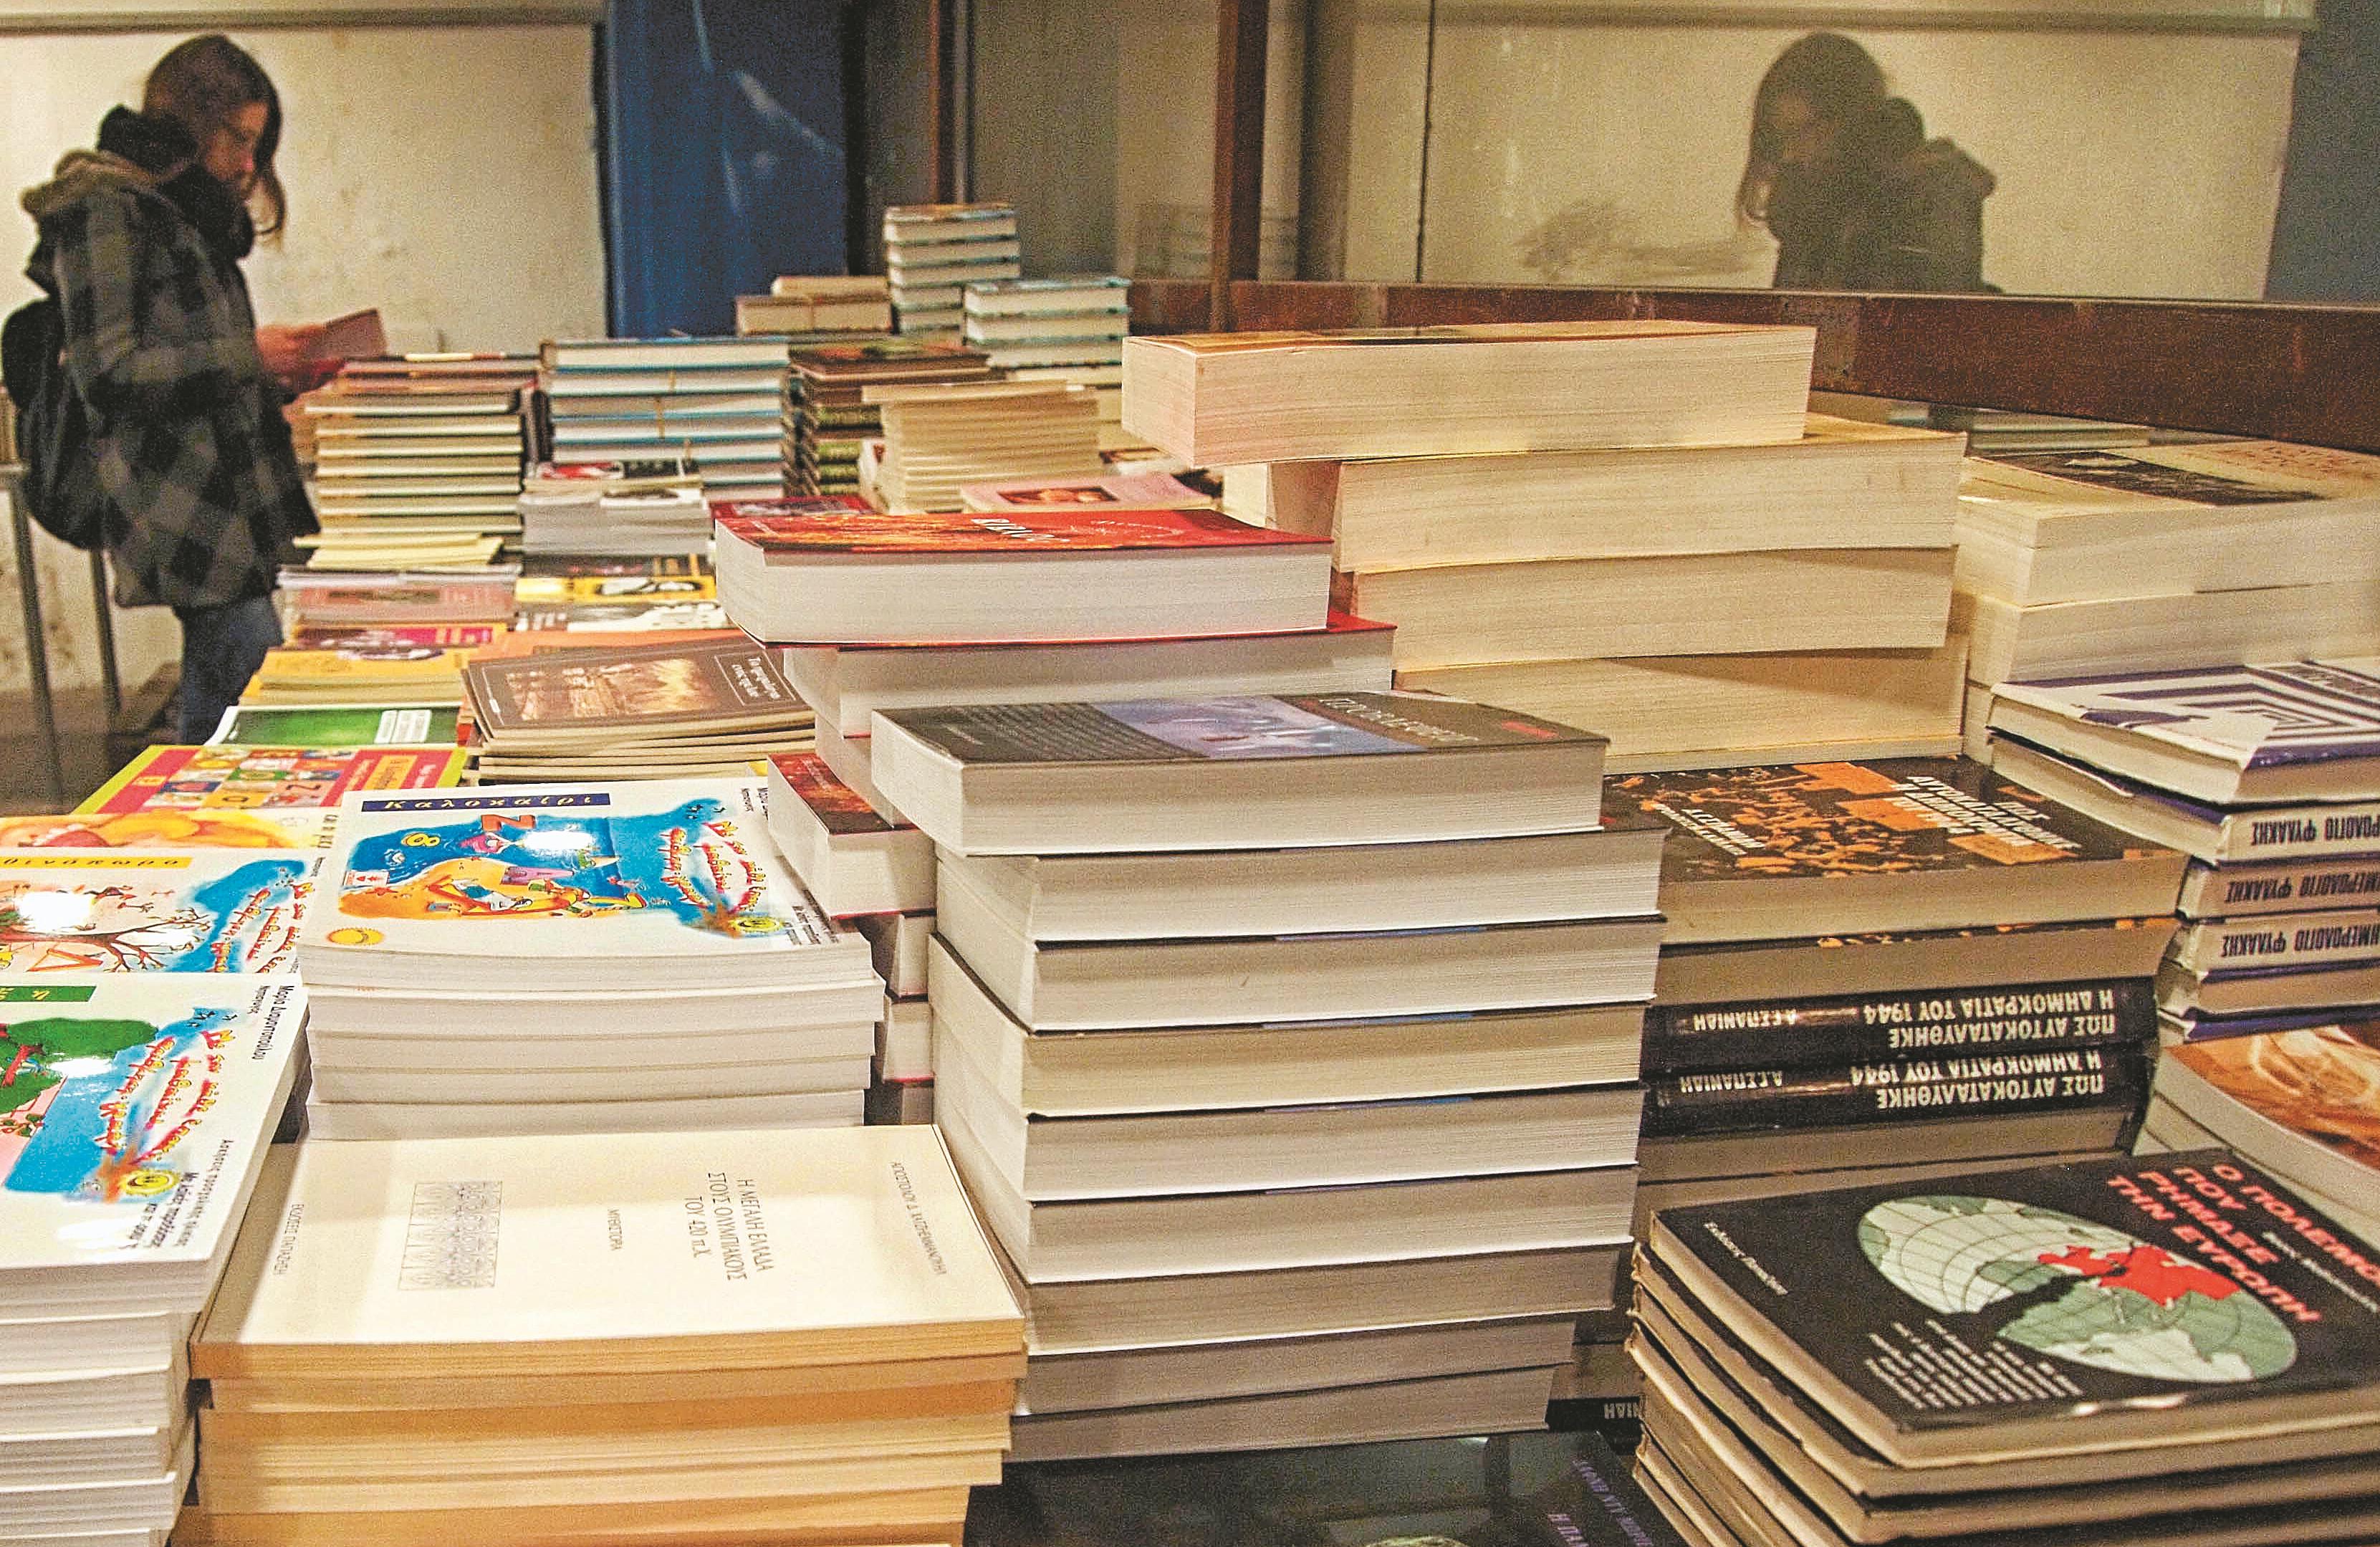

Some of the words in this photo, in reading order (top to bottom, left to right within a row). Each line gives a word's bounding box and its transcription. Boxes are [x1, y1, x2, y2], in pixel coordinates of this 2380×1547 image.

[2252, 820, 2316, 846] ΦΥΛΑΚΗΣ
[2225, 878, 2292, 904] ΦΥΛΑΚΗΣ
[2221, 931, 2286, 957] ΦΥΛΑΚΗΣ
[2293, 923, 2380, 952] ΗΜΕΡΟΛΟΓΙΟ
[272, 985, 294, 1005] Μαρία
[1960, 992, 2092, 1018] ΔΗΜΟΚΡΑΤΙΑ
[2098, 990, 2114, 1010] Η
[1863, 1001, 1913, 1025] 1944
[1918, 1000, 1955, 1022] ΤΟΥ
[251, 1006, 287, 1060] Διαμαντοπούλου
[1889, 1017, 2068, 1048] ΑΥΤΟΚΑΤΑΛΥΘΗΚΕ
[2073, 1014, 2116, 1036] ΠΩΣ
[1905, 1061, 1942, 1083] ΤΟΥ
[1948, 1051, 2081, 1078] ΔΗΜΟΚΡΑΤΙΑ
[2086, 1050, 2102, 1070] Η
[1851, 1065, 1899, 1087] 1944
[2061, 1074, 2103, 1095] ΠΩΣ
[1877, 1077, 2056, 1109] ΑΥΤΟΚΑΤΑΛΥΘΗΚΕ
[2213, 1164, 2243, 1182] Ο
[708, 1172, 731, 1204] ΣΤΟΥΣ
[2107, 1175, 2177, 1220] ΤΗΝ
[2172, 1166, 2248, 1211] ΠΟΥ
[284, 1204, 304, 1234] ΕΚΔΟΣΕΙΣ
[685, 1197, 705, 1216] ΤΟΥ
[739, 1190, 764, 1230] ΜΕΓΑΛΗ
[272, 1236, 296, 1275] ΠΑΠΑΖΗΣΗ
[714, 1207, 747, 1280] ΟΛΥΜΠΙΑΚΟΥΣ
[749, 1233, 774, 1272] ΕΛΛΑΔΑ
